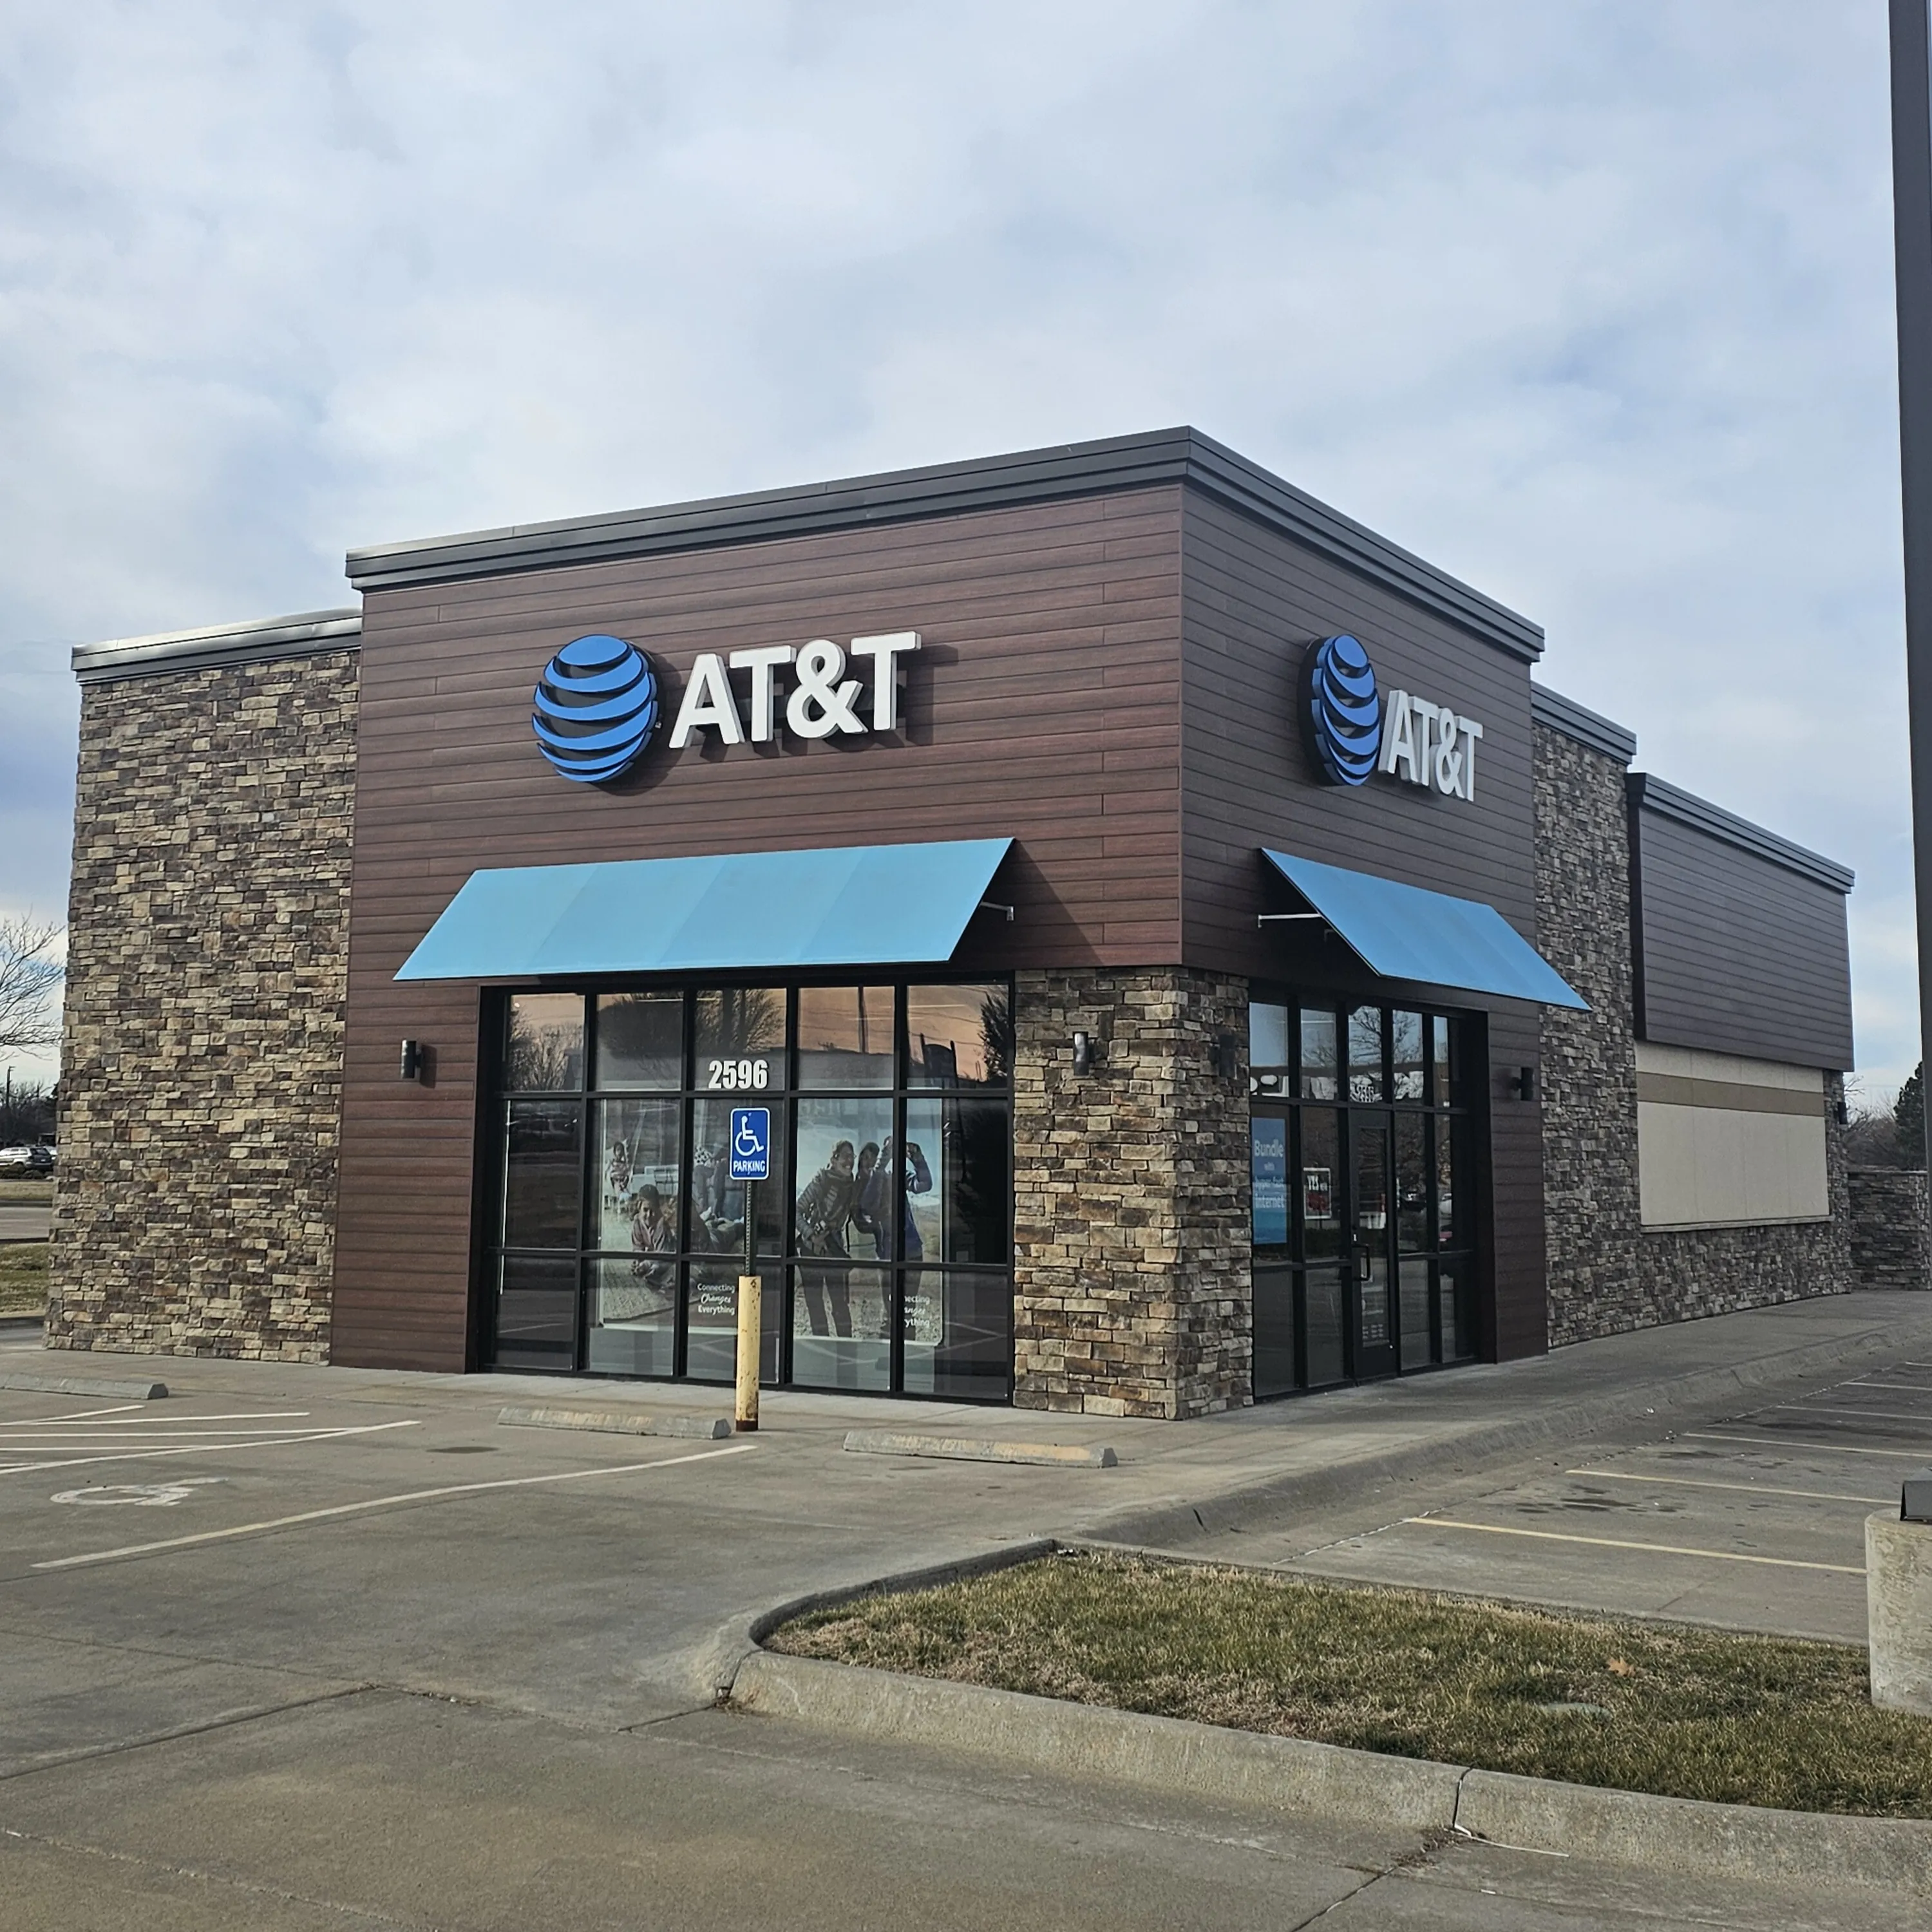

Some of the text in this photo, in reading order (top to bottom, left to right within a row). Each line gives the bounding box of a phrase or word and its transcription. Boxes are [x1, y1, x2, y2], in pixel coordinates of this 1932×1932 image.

[668, 630, 921, 748] AT&T
[1378, 689, 1483, 802] AT&T
[708, 1059, 768, 1089] 2596
[1254, 1139, 1284, 1158] Bundle
[733, 1160, 766, 1173] PARKING
[1255, 1193, 1285, 1209] internet
[697, 1283, 735, 1294] Connecting
[701, 1293, 732, 1305] Changes
[697, 1305, 735, 1316] Everything
